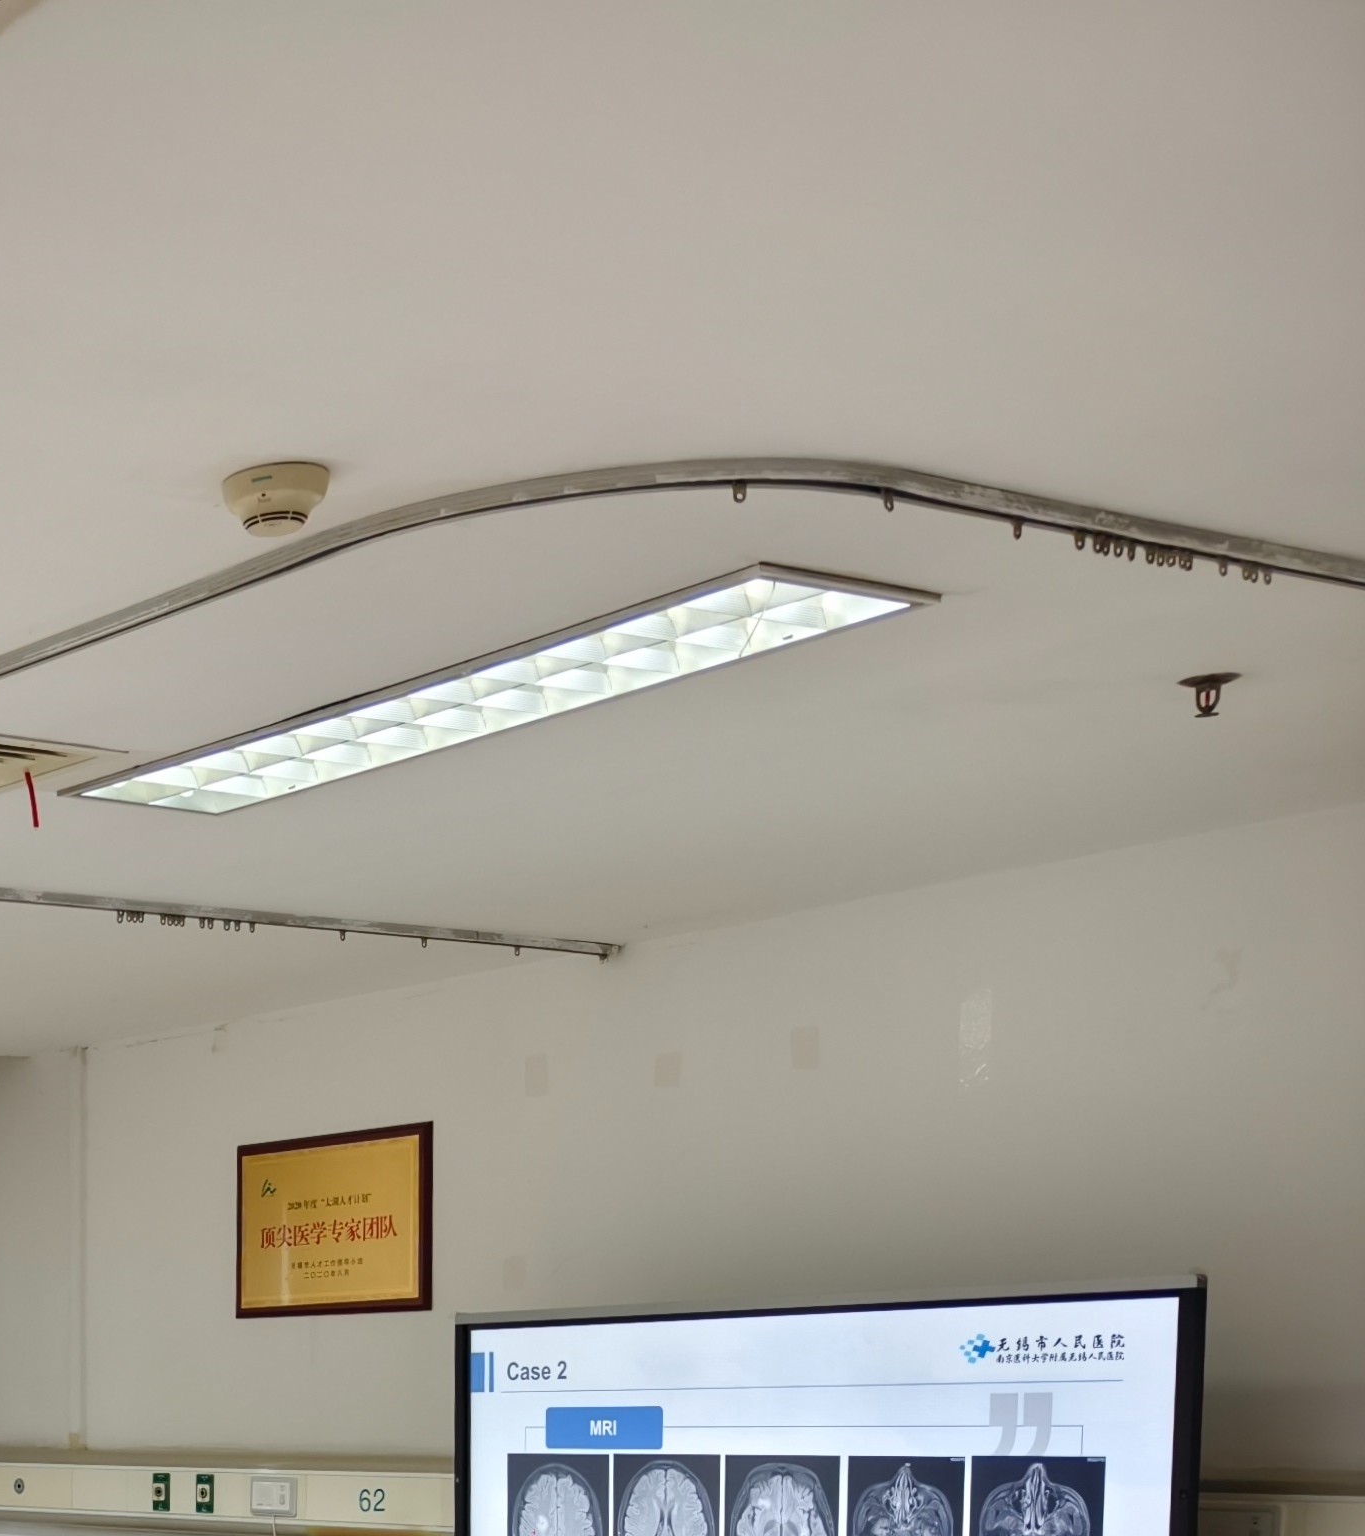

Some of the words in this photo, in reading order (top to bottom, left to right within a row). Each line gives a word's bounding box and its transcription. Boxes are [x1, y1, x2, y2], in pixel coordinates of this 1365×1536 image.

[260, 1214, 397, 1249] 顶尖医学专家团队
[996, 1334, 1125, 1352] 无锡市人民医院
[507, 1362, 551, 1380] Case
[557, 1360, 567, 1380] 2
[590, 1420, 617, 1436] MRI
[359, 1488, 386, 1512] 62
